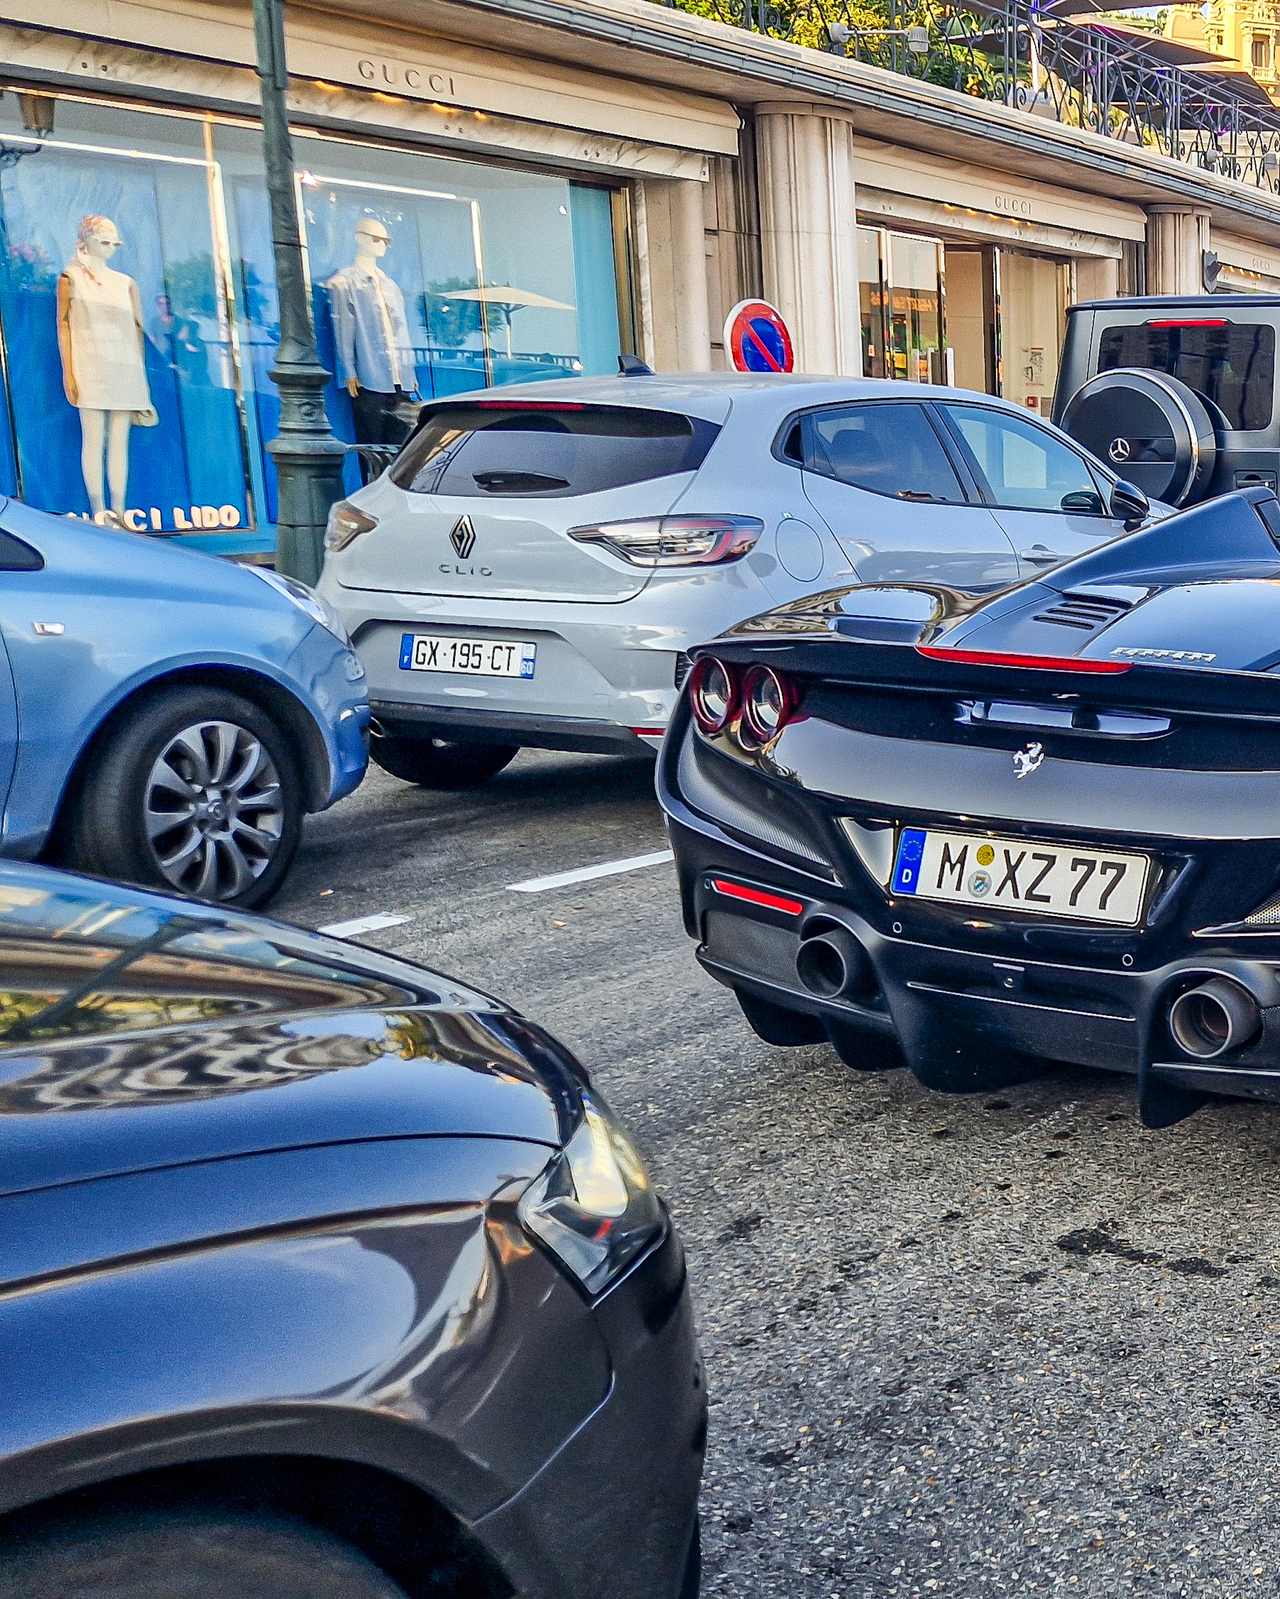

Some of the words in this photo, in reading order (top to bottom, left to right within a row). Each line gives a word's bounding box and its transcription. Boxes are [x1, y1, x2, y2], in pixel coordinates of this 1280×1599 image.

[357, 59, 455, 96] GUCCI
[994, 195, 1031, 215] GUCCI
[173, 504, 241, 529] LIDO
[438, 564, 493, 577] CLIO
[403, 655, 410, 664] F
[415, 639, 516, 672] GX-195-CT
[902, 868, 912, 884] D
[936, 841, 969, 892] M
[995, 849, 1057, 903] XZ
[1069, 857, 1127, 910] 77
